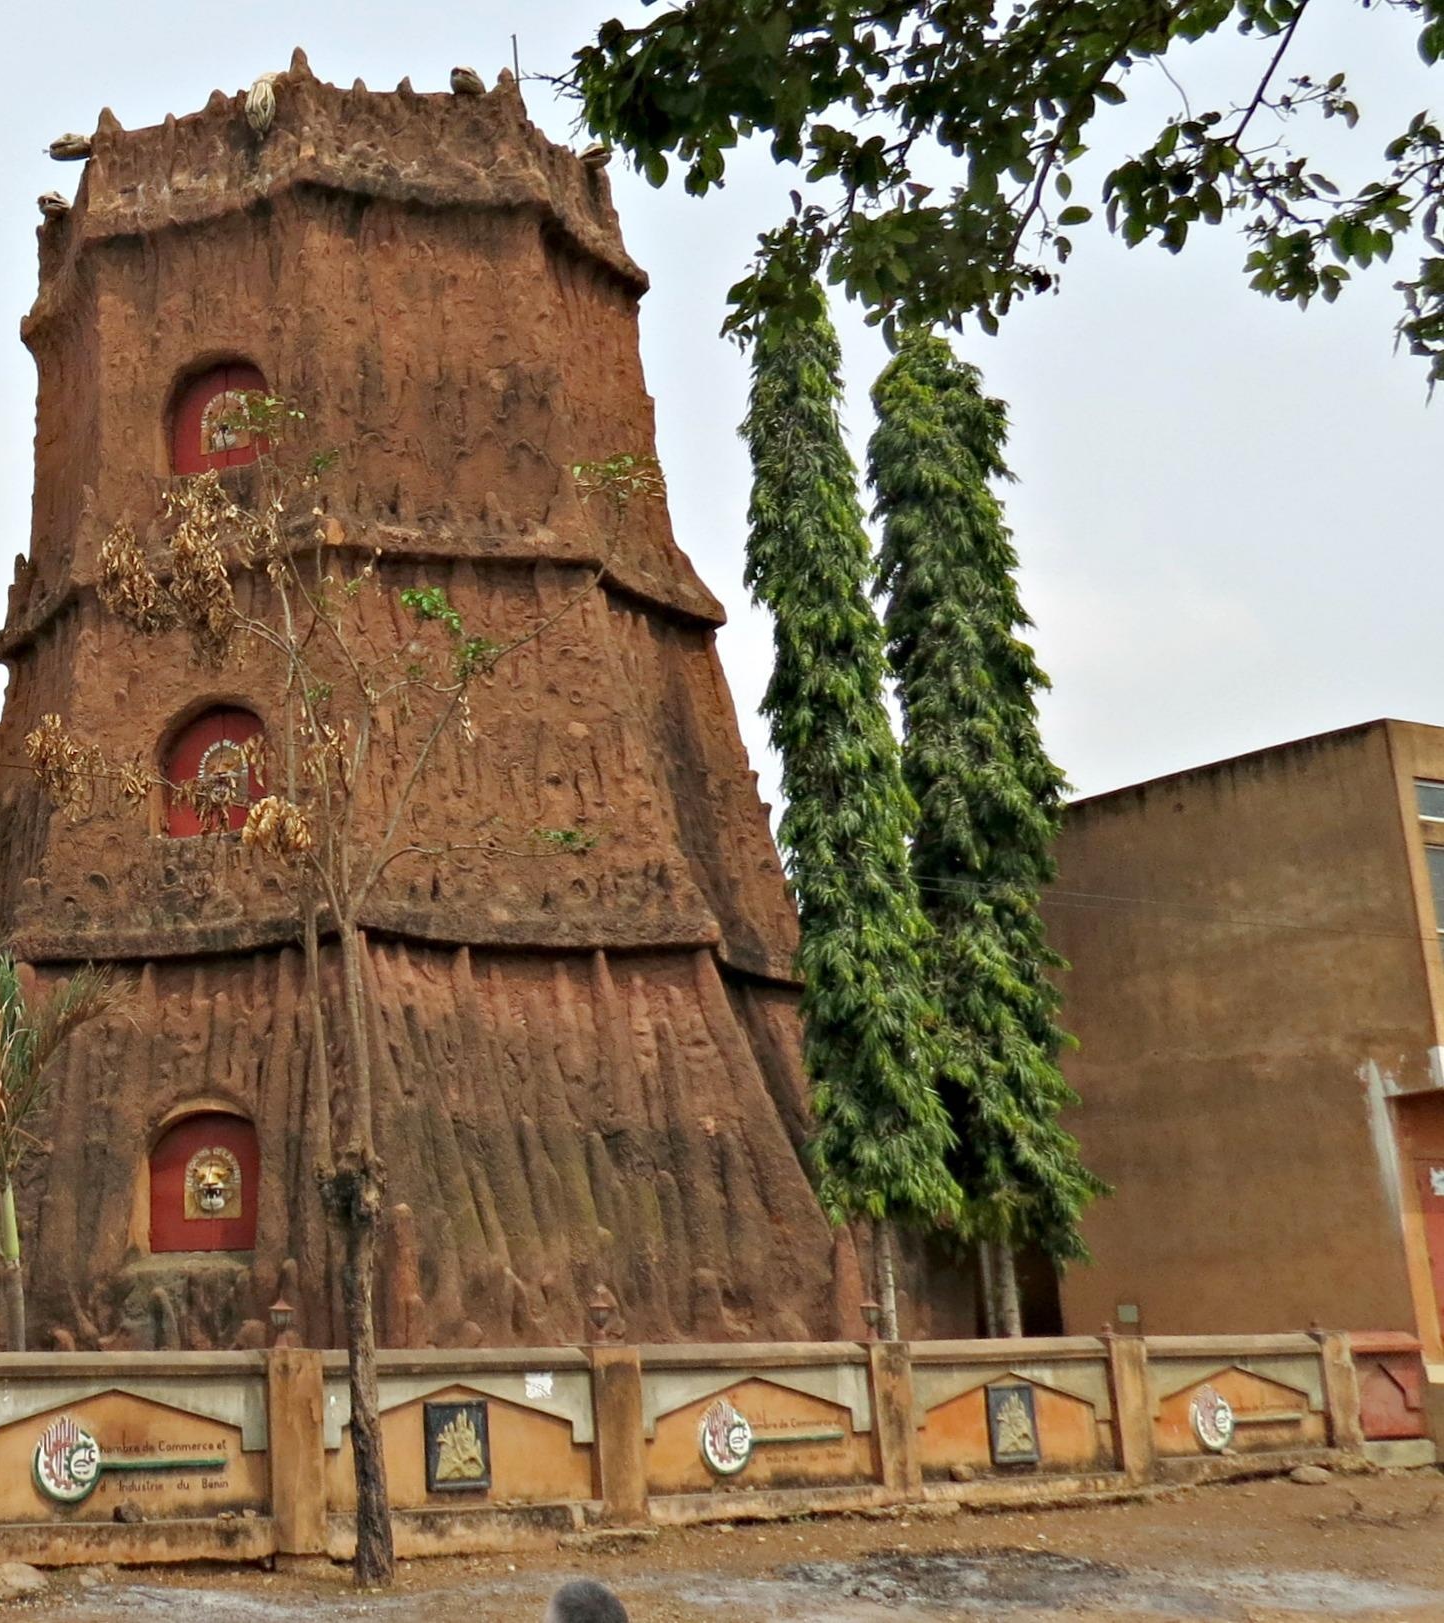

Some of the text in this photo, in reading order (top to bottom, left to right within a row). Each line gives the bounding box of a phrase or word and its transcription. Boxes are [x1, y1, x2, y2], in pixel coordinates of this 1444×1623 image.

[158, 1439, 213, 1452] Commerce
[216, 1439, 227, 1451] et
[176, 1479, 190, 1490] du
